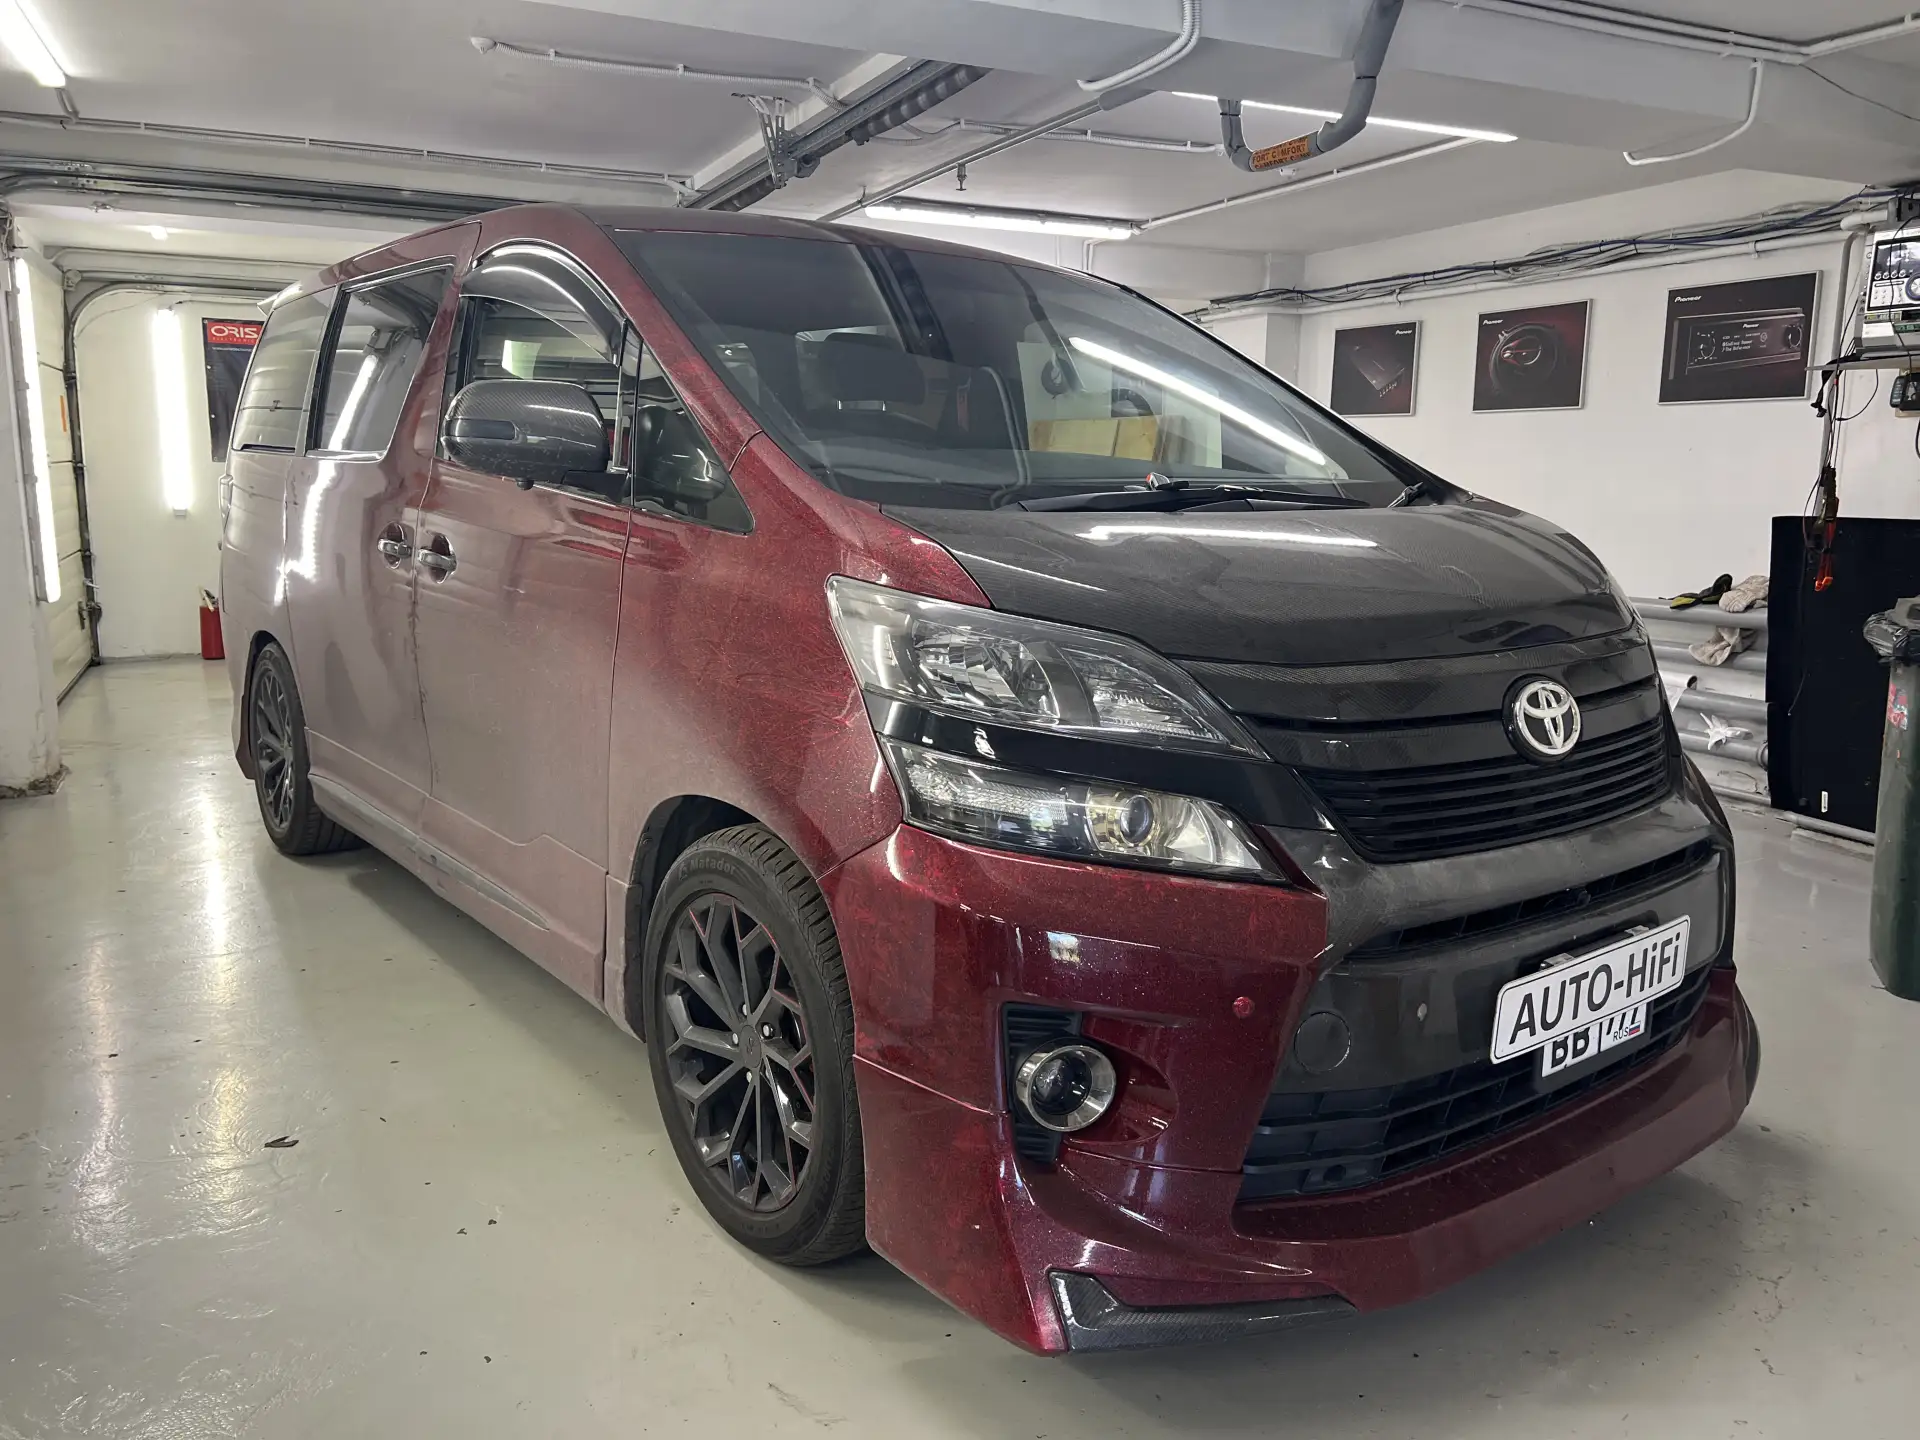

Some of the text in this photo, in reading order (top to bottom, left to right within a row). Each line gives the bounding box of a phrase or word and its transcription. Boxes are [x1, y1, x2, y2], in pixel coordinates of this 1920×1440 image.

[211, 325, 258, 339] ORIS
[689, 857, 736, 875] Matador
[1509, 931, 1681, 1045] AUTO-HiFi
[1613, 1026, 1629, 1042] RUS
